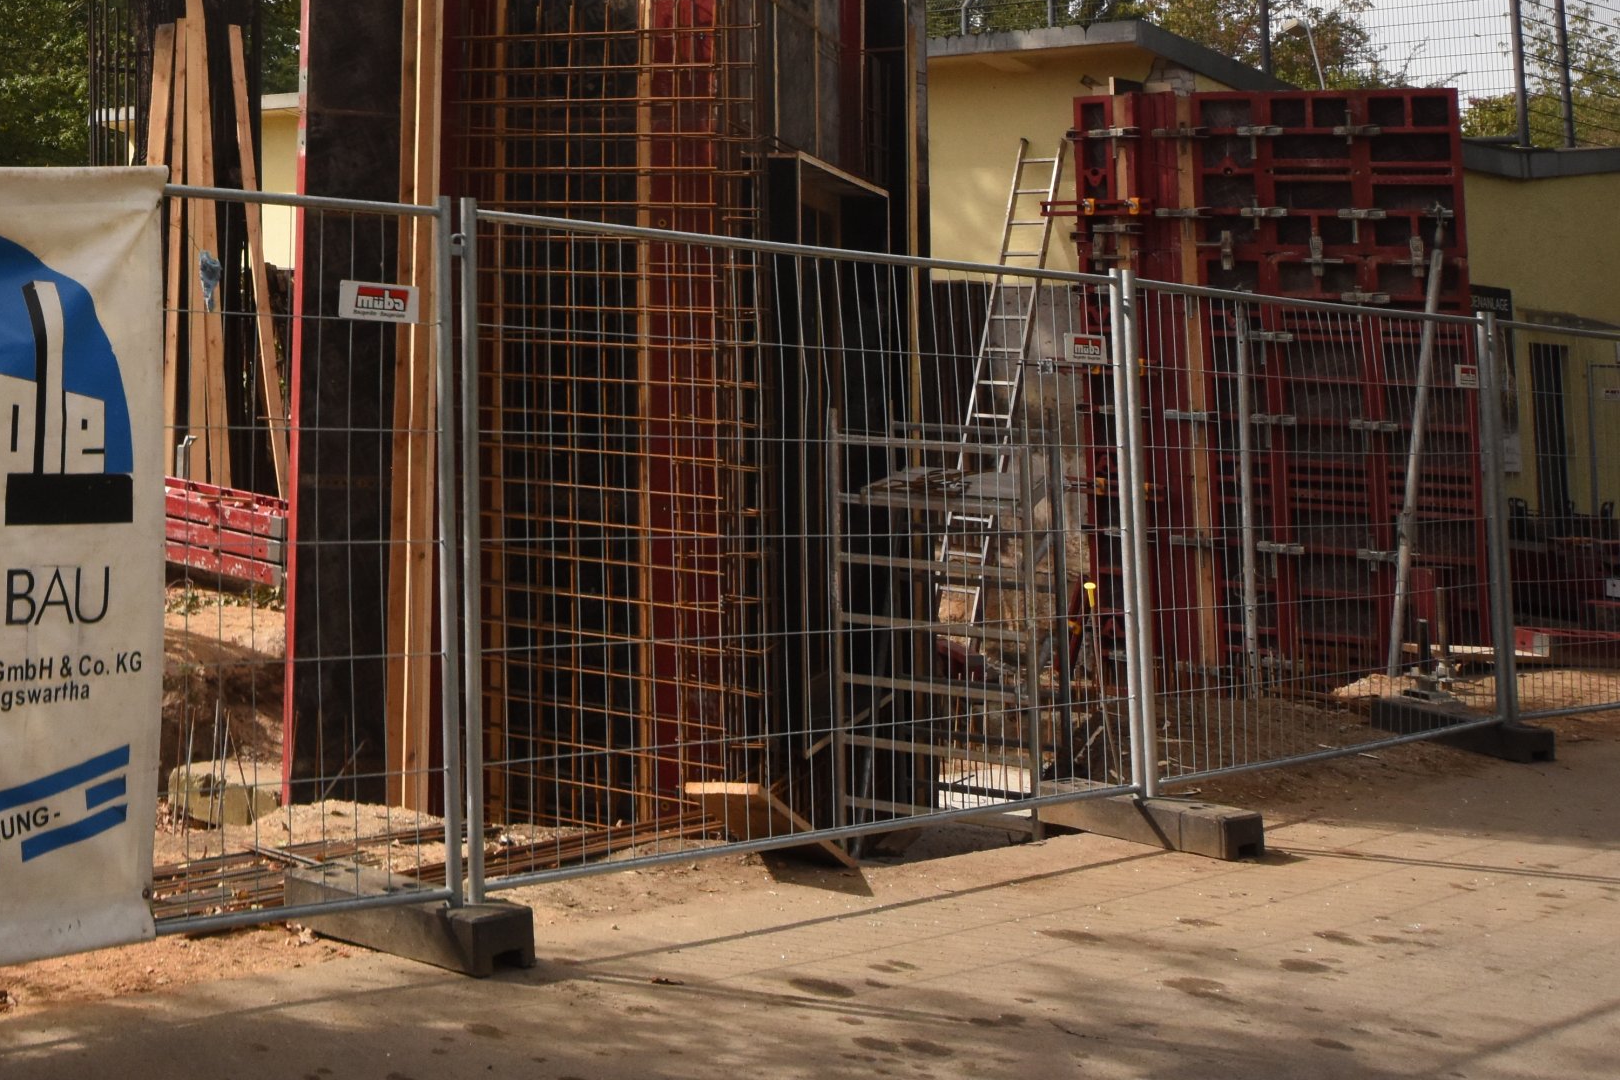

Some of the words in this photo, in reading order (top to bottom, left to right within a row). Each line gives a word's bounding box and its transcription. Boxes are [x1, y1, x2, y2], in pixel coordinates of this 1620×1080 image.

[356, 289, 406, 312] müba
[1073, 339, 1101, 355] müba
[60, 655, 73, 678] &
[79, 655, 110, 677] Co.
[116, 651, 142, 674] KG
